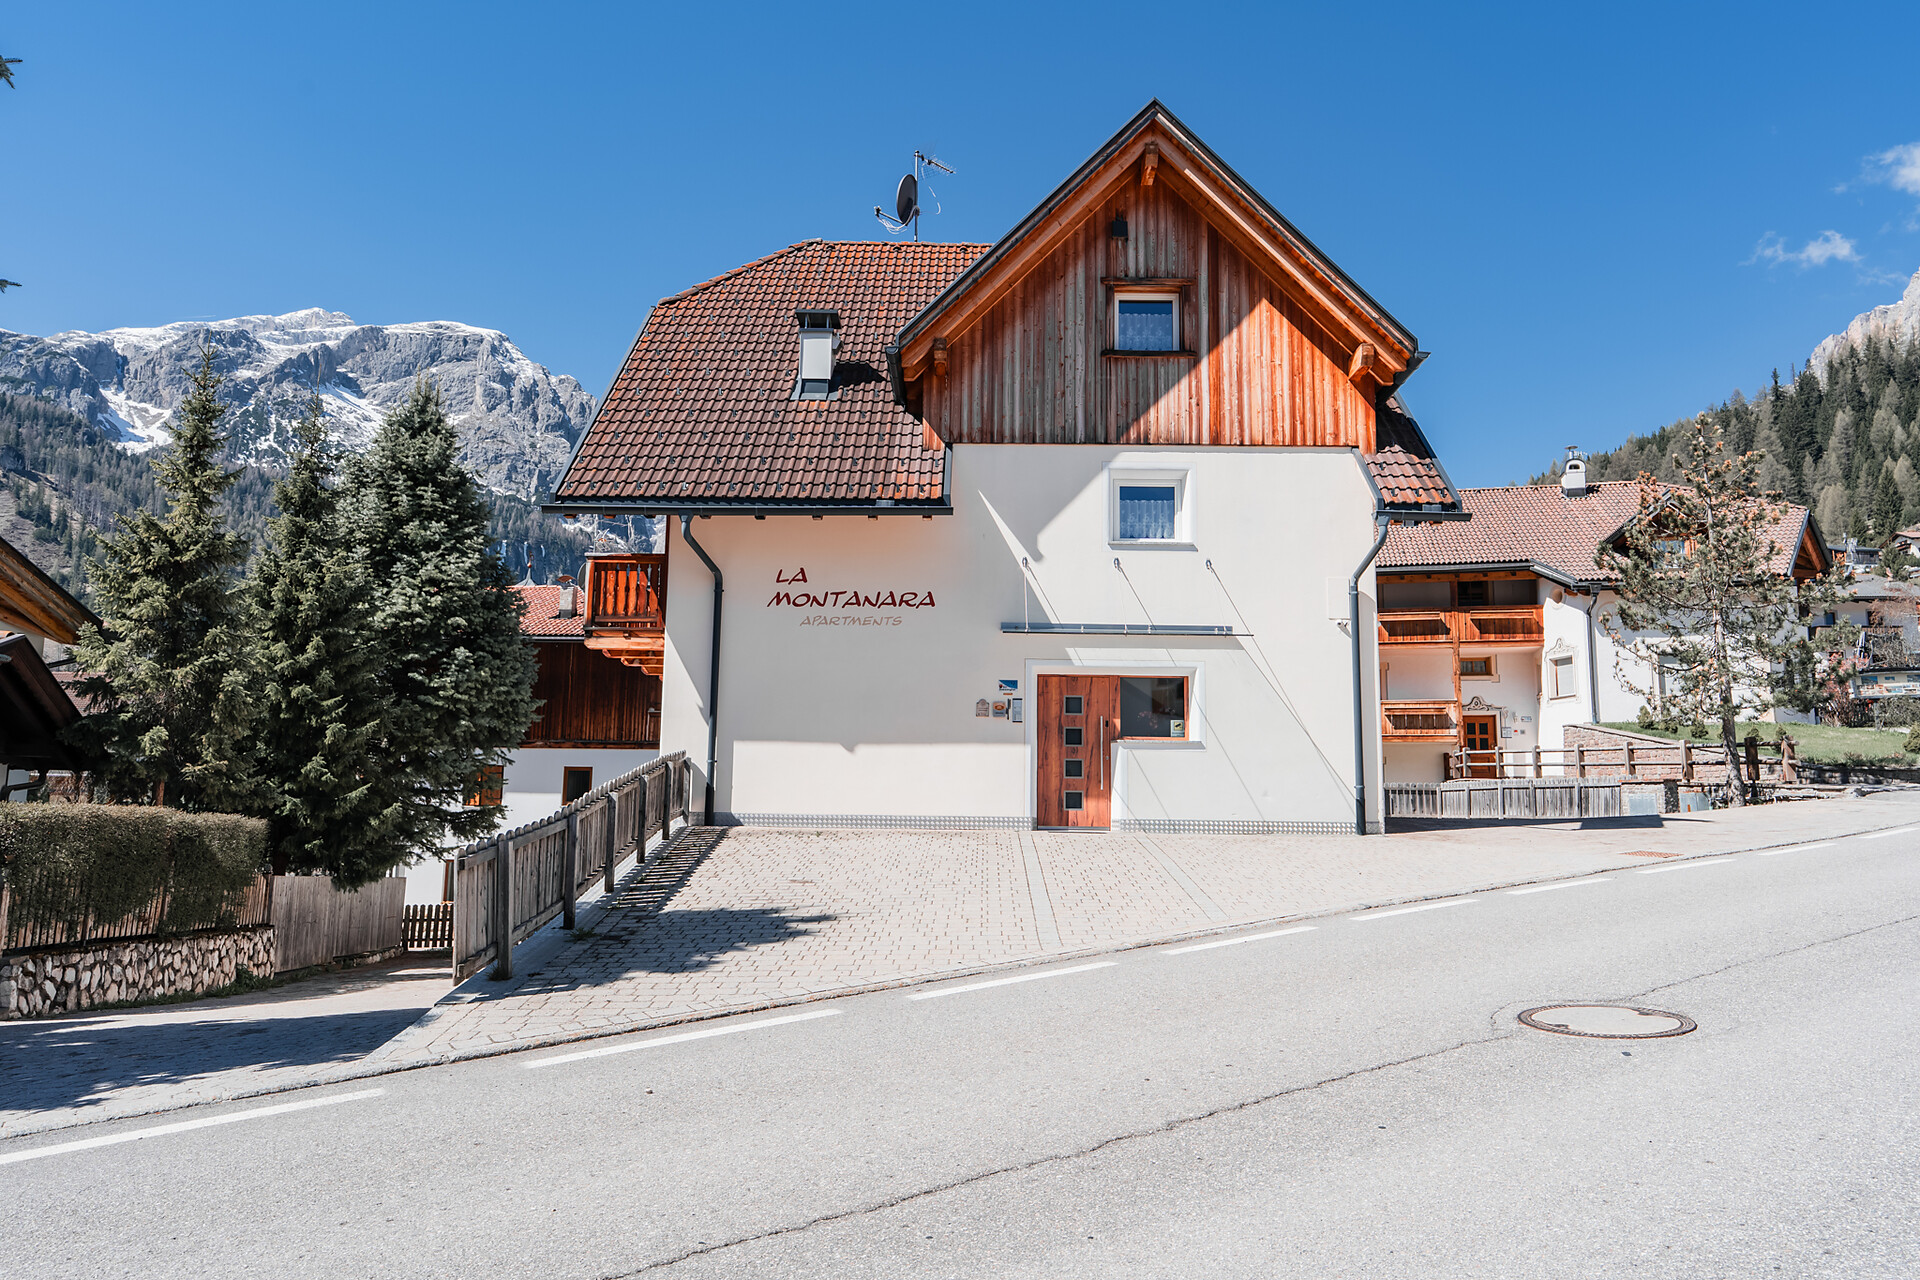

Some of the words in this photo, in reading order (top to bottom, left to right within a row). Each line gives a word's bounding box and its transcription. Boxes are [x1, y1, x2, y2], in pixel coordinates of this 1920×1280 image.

[775, 567, 808, 585] LA
[766, 591, 936, 609] MONTANARA
[799, 615, 903, 627] APARTMENTS
